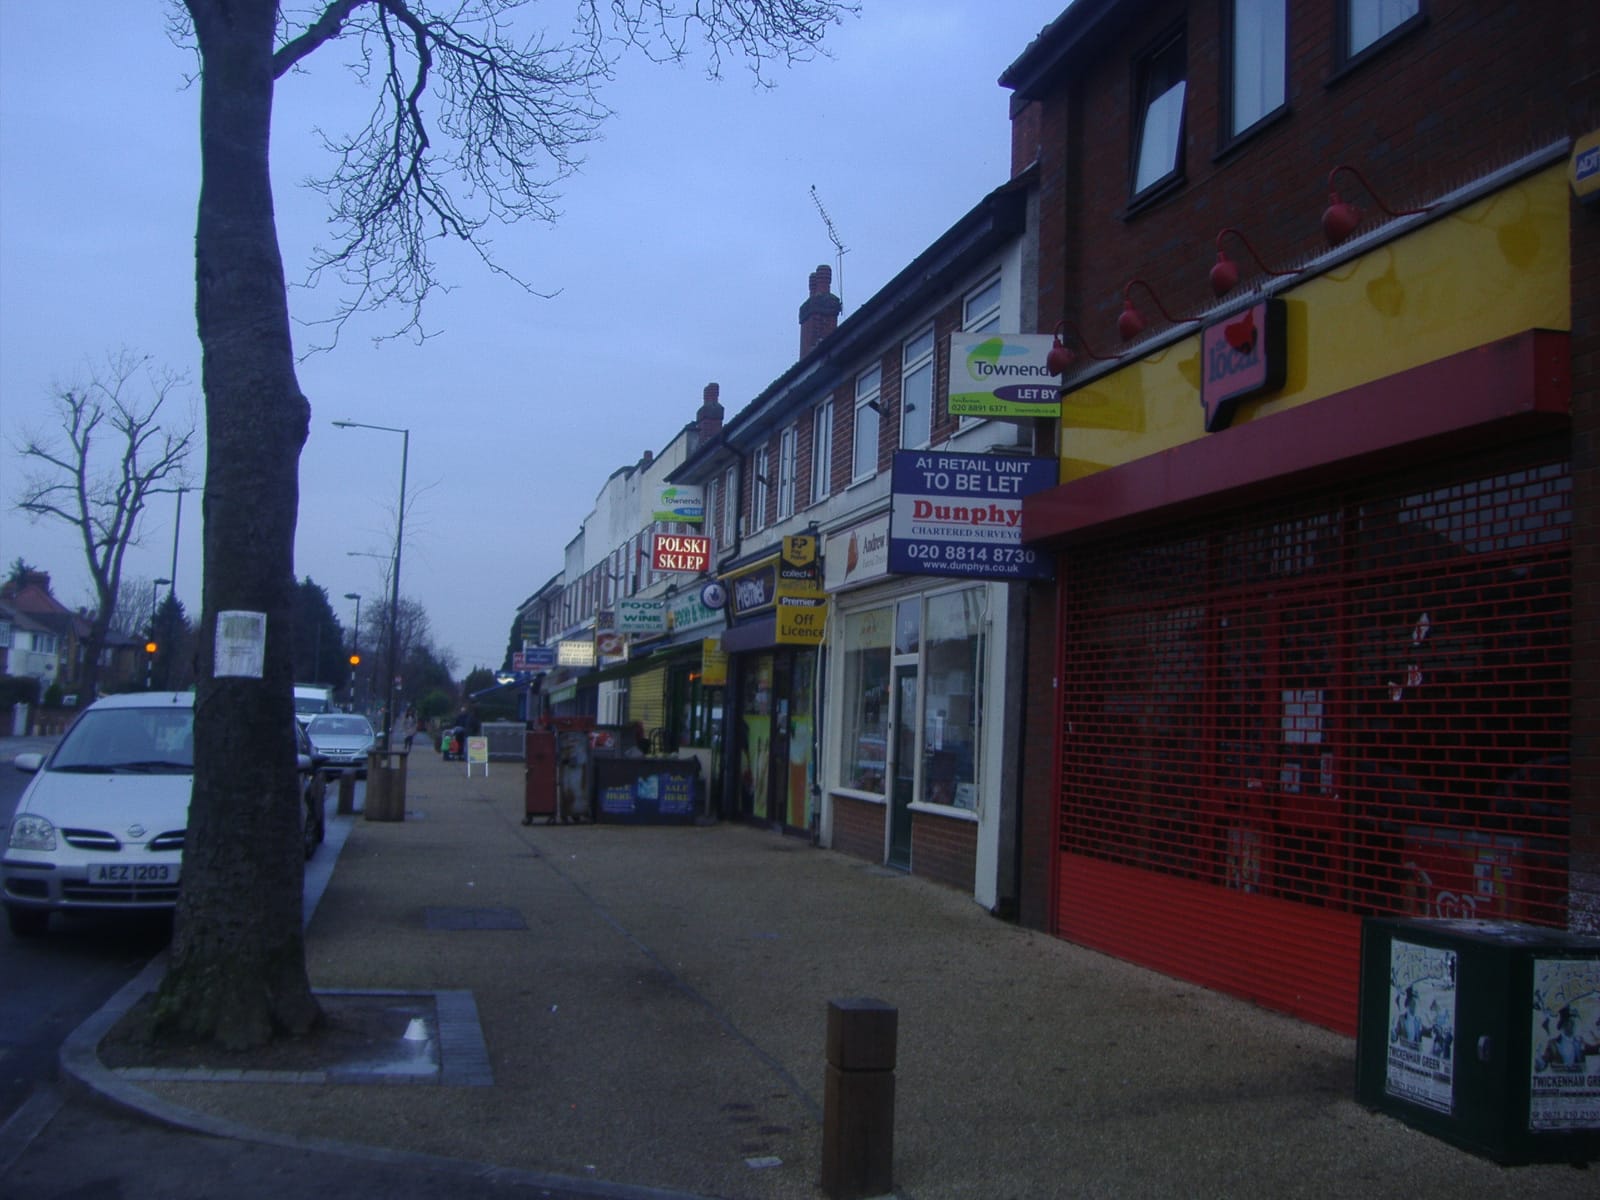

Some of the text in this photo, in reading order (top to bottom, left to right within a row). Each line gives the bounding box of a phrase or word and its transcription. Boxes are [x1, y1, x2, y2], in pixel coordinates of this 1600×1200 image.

[974, 360, 1050, 377] Townend
[1018, 389, 1057, 400] LET BY
[916, 457, 1031, 474] A1 RETAIL UNIT
[923, 472, 1022, 493] TO BE LET
[913, 499, 1023, 527] Dunphy
[912, 526, 1022, 539] CHARTERED SURVEYO
[657, 537, 707, 554] POLSKI
[863, 532, 885, 554] Andrew
[908, 544, 1036, 563] 020 8814 8730
[658, 554, 704, 570] SKLEP
[923, 560, 1019, 573] www.dunphys.co.uk
[782, 597, 816, 606] Premier
[794, 613, 815, 625] Off
[781, 624, 824, 638] Licence
[100, 865, 168, 880] AEZ 1203
[1533, 1075, 1585, 1088] TWICKENHAM
